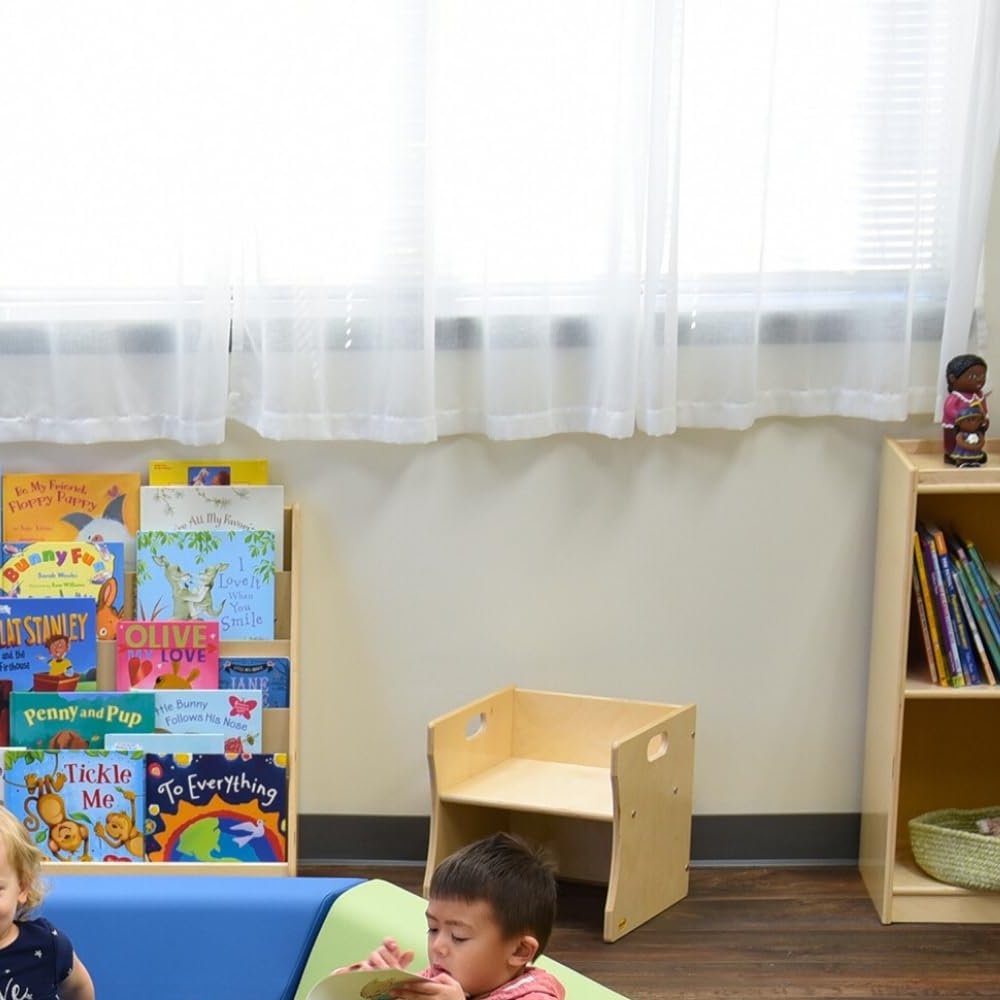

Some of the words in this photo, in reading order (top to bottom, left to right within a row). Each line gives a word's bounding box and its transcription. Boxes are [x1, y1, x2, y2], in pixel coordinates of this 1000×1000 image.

[14, 486, 29, 497] Be
[31, 480, 46, 493] My
[8, 494, 53, 513] Floppy
[56, 490, 98, 512] Puppy
[206, 512, 222, 528] My
[2, 550, 67, 583] Bunny
[71, 548, 105, 572] Fun
[238, 556, 244, 572] I
[219, 574, 249, 589] Love
[250, 574, 261, 590] It
[229, 602, 250, 613] You
[23, 612, 88, 647] STANLEY
[220, 611, 263, 632] Smile
[125, 624, 208, 649] OLIVE
[161, 649, 207, 663] LOVE
[231, 676, 269, 690] JANE
[176, 699, 208, 711] Bunny
[23, 705, 79, 727] Penny
[79, 707, 105, 719] and
[106, 705, 143, 728] Pup
[165, 713, 202, 727] Follows
[204, 713, 221, 725] His
[223, 718, 248, 732] Nose
[64, 763, 132, 784] Tickle
[82, 788, 115, 810] Me
[157, 778, 184, 804] To
[187, 771, 278, 807] Everything
